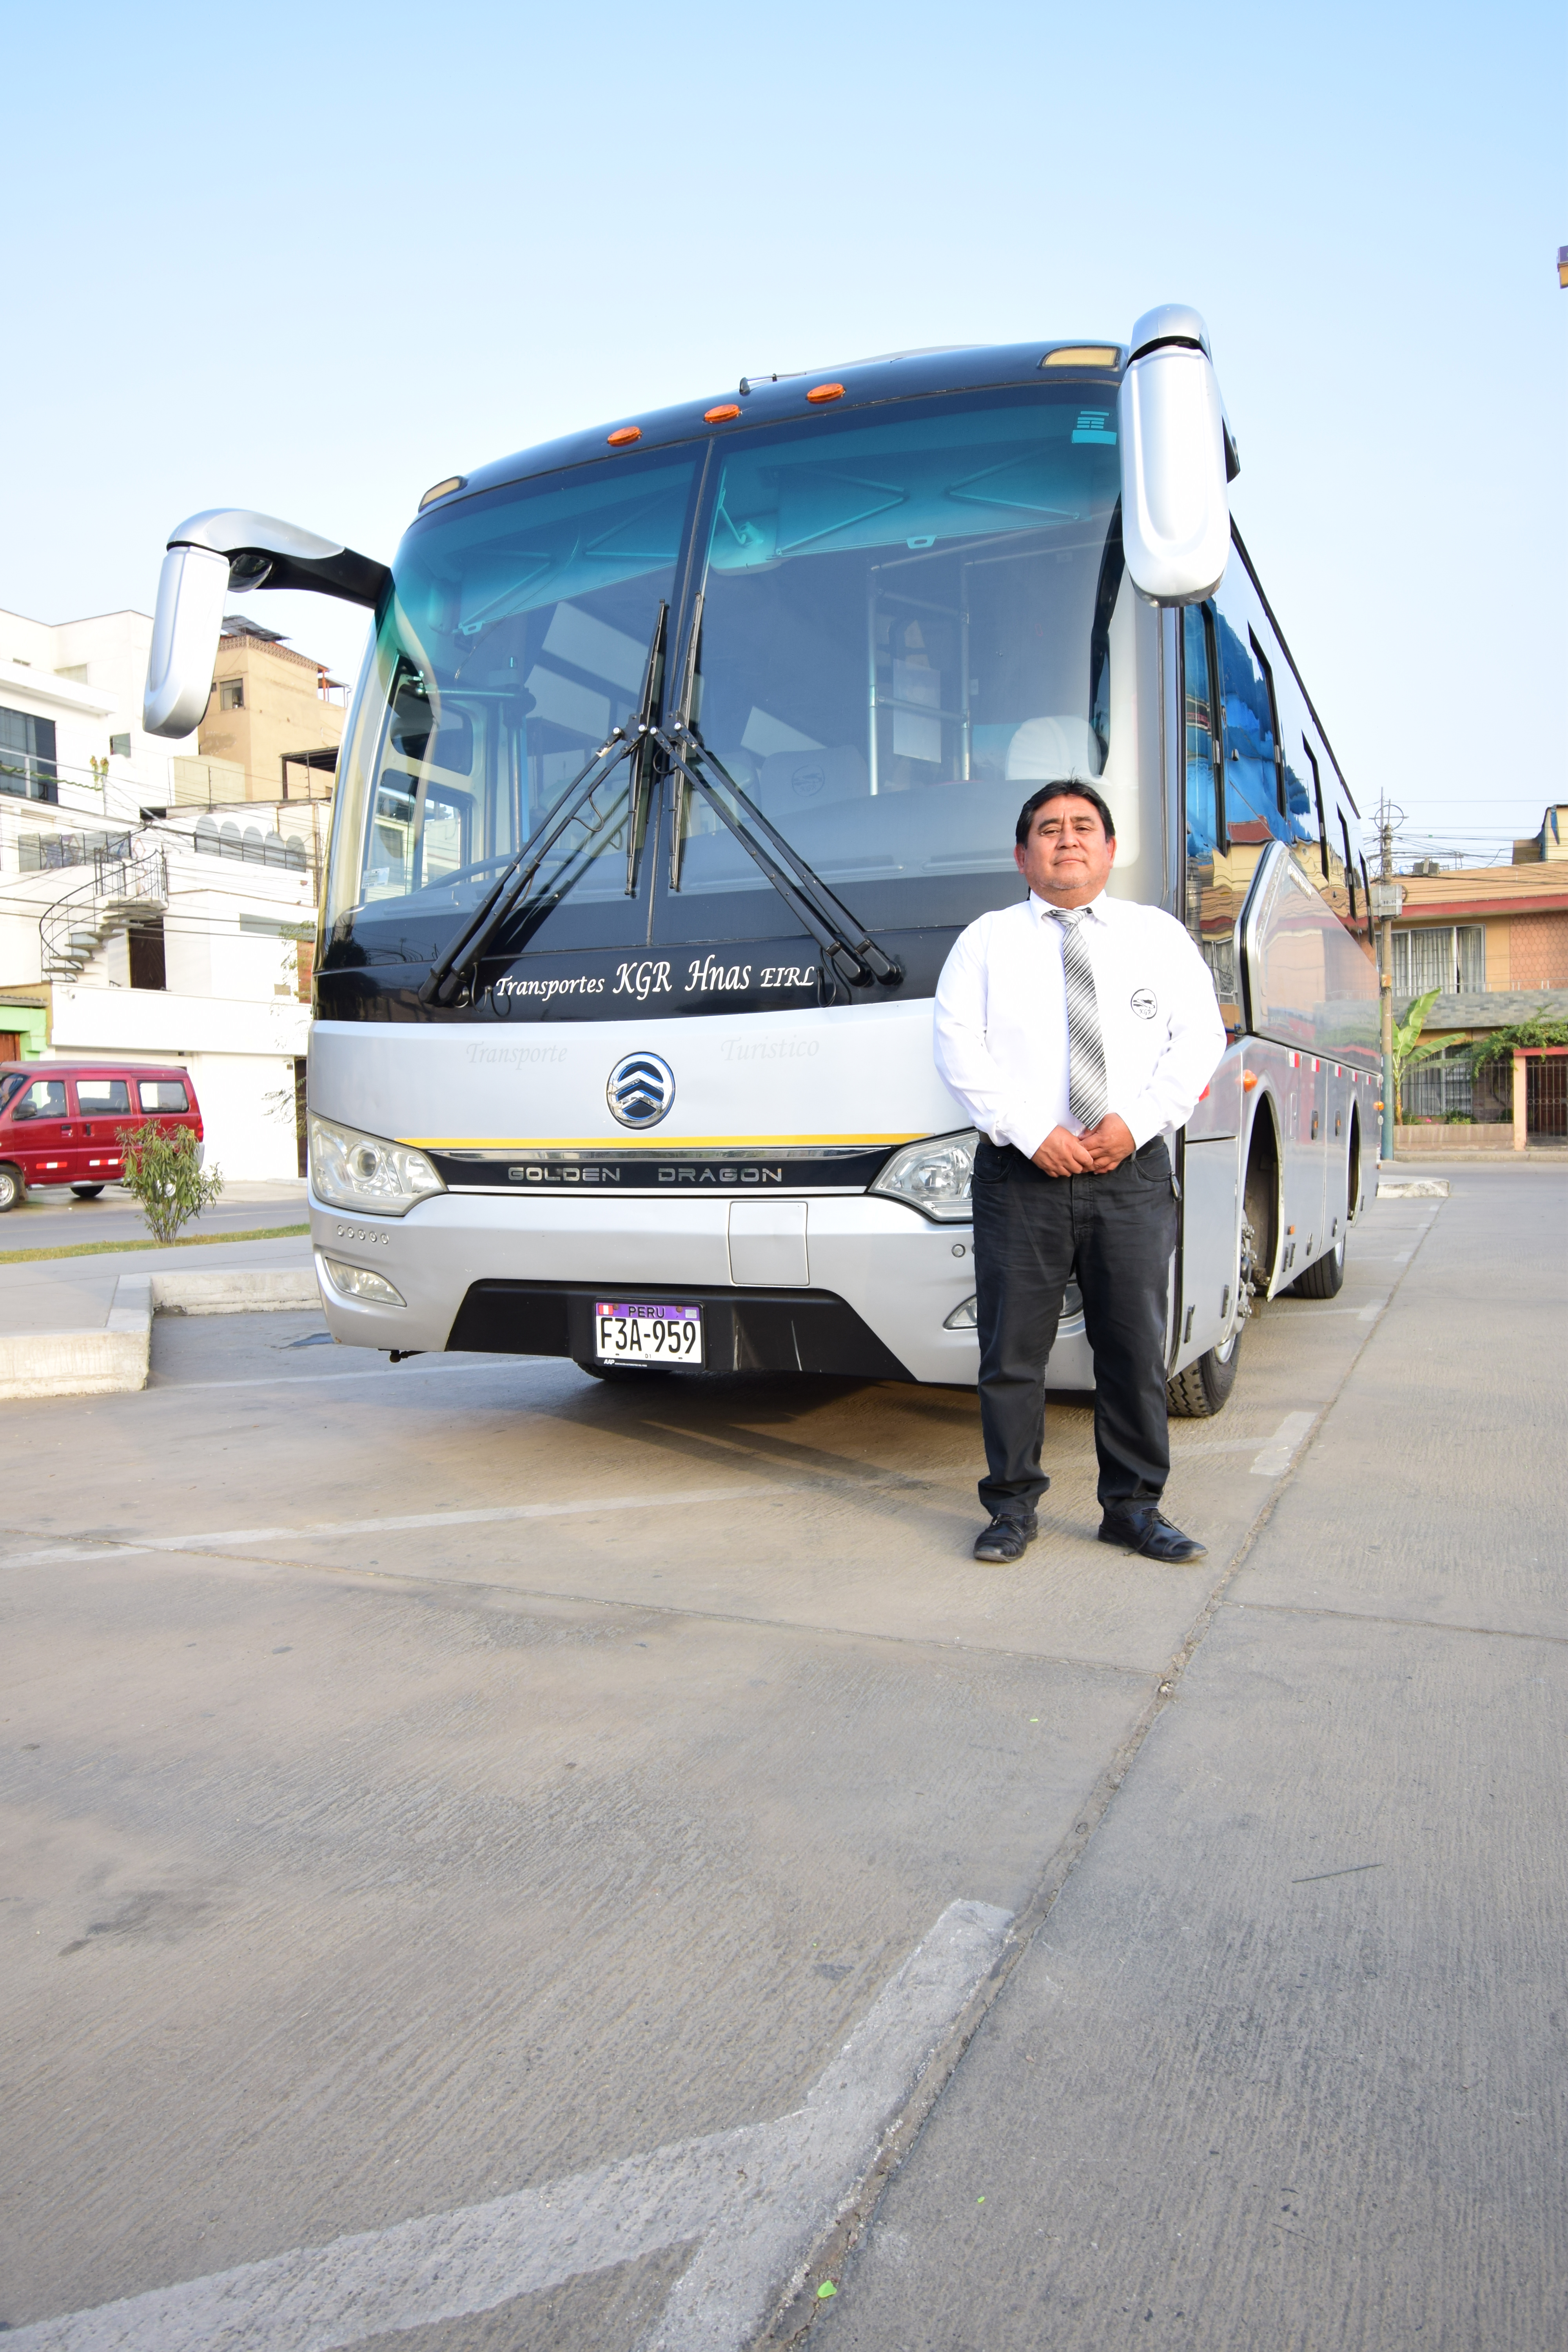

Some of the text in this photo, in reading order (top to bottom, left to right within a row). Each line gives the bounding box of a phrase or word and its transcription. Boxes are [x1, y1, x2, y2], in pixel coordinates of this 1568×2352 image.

[496, 954, 815, 1001] Transportes KGR Hnas EIRL
[466, 1041, 568, 1070] Transporte
[508, 1167, 782, 1182] GOLDEN DRAGON
[628, 1306, 665, 1318] PERU
[601, 1317, 696, 1354] F3A-959
